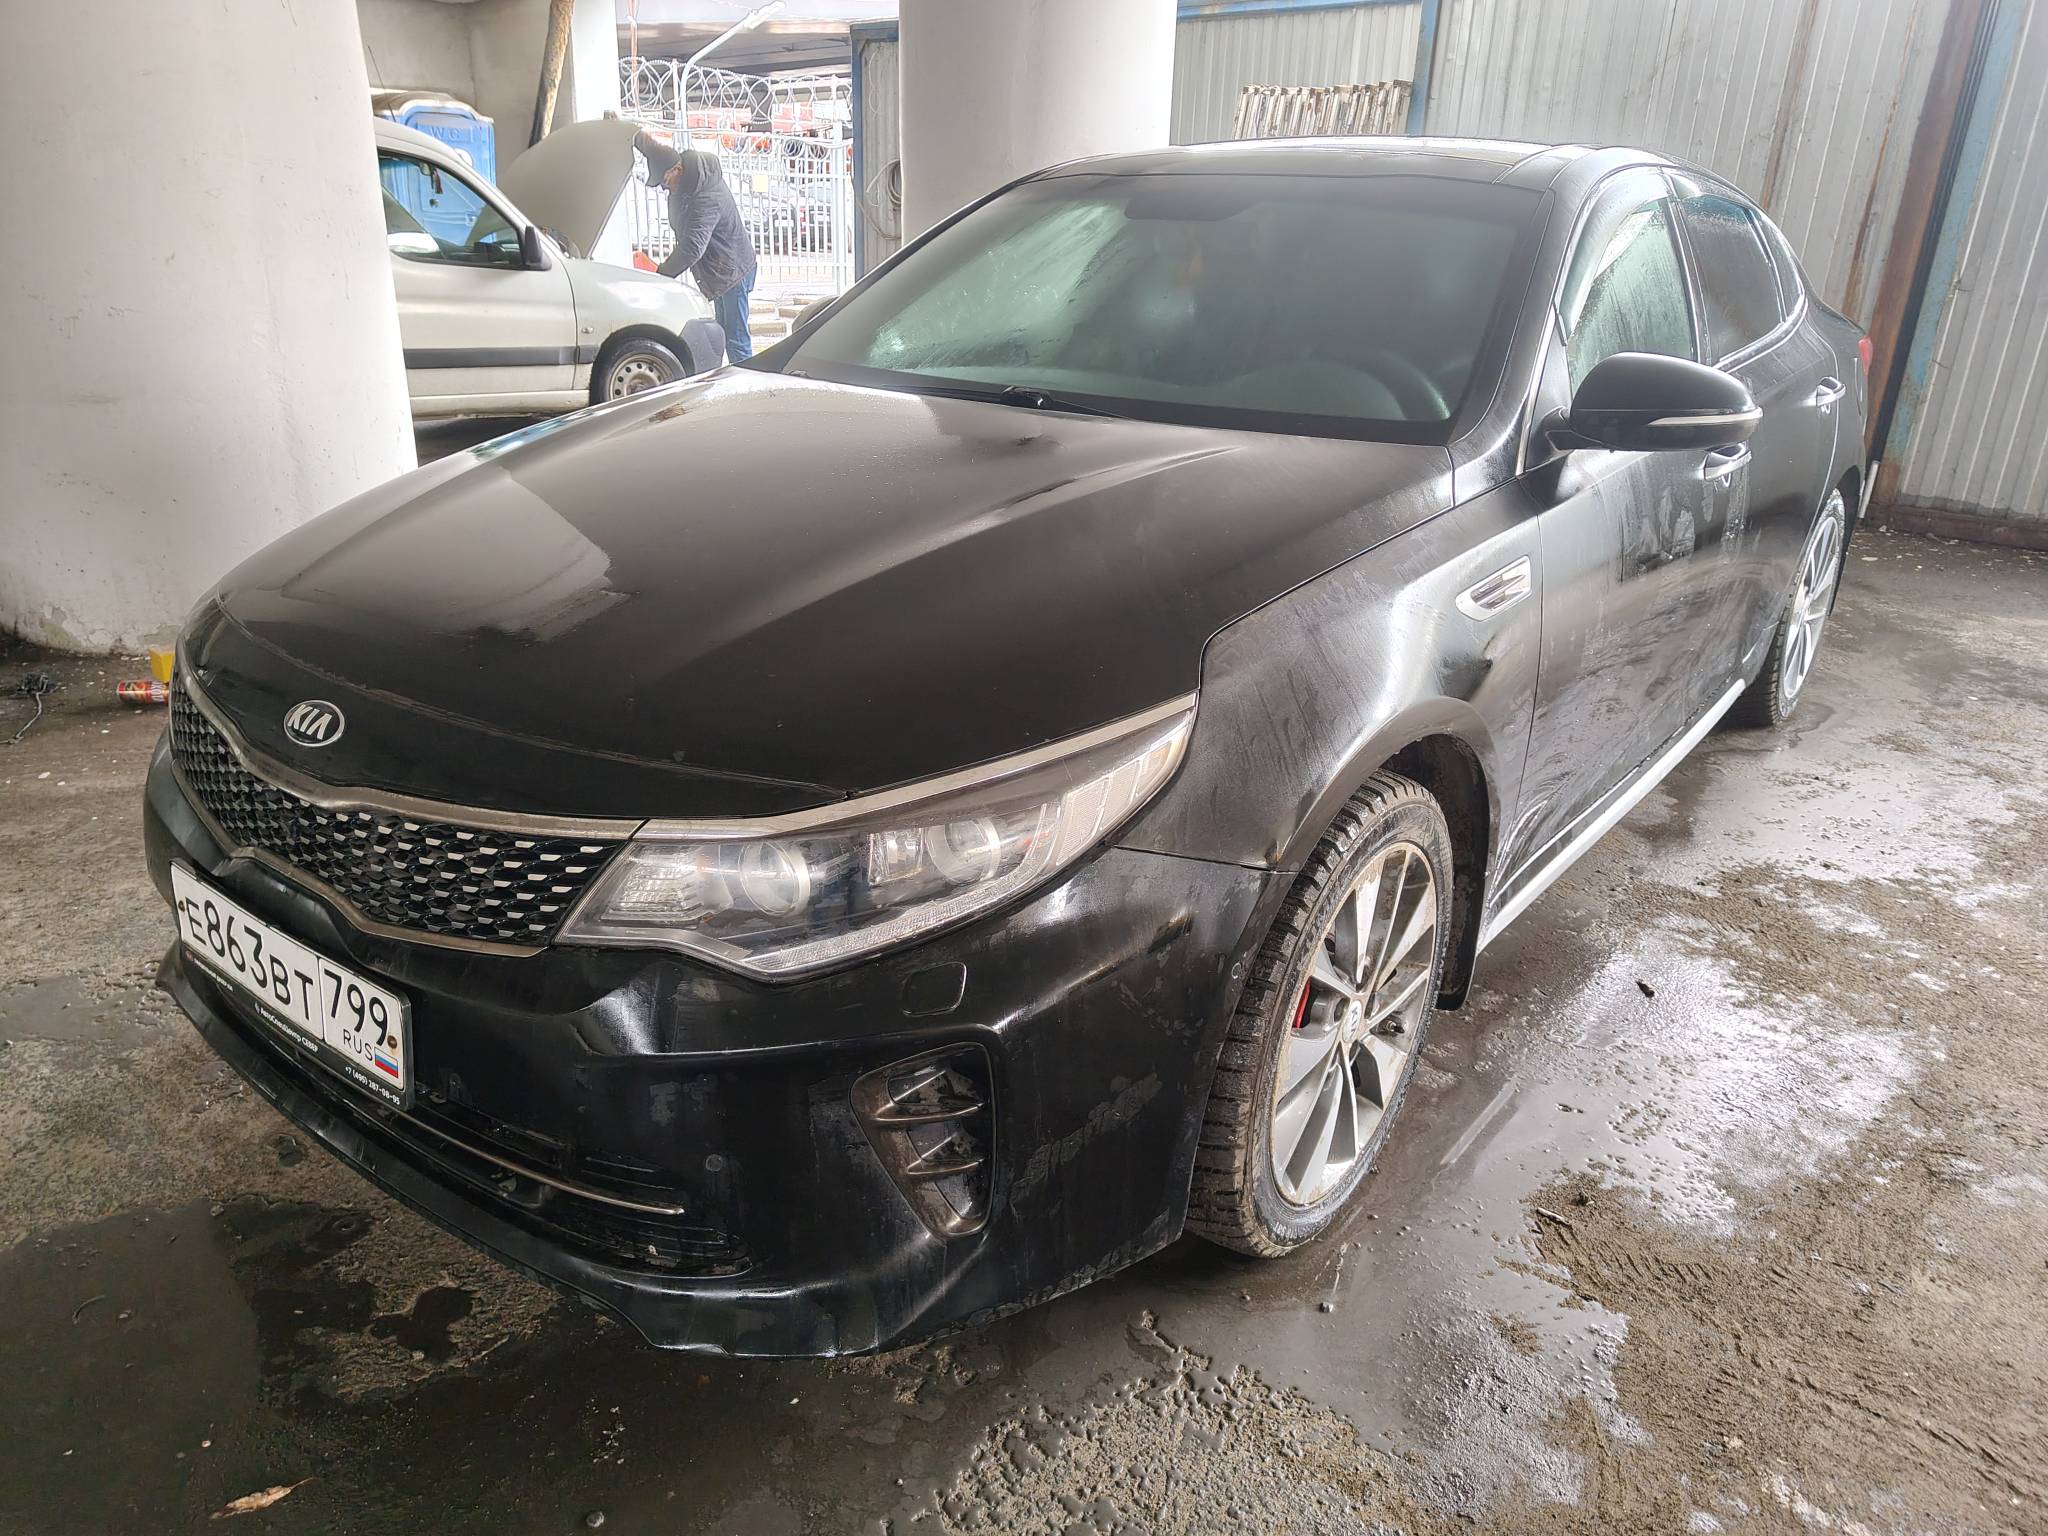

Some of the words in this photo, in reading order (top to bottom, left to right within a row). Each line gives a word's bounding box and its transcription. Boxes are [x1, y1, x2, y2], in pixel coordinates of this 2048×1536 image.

[287, 704, 332, 740] KIA
[184, 896, 314, 1021] Е863ВТ
[324, 969, 389, 1047] 799
[343, 1028, 373, 1062] RUS
